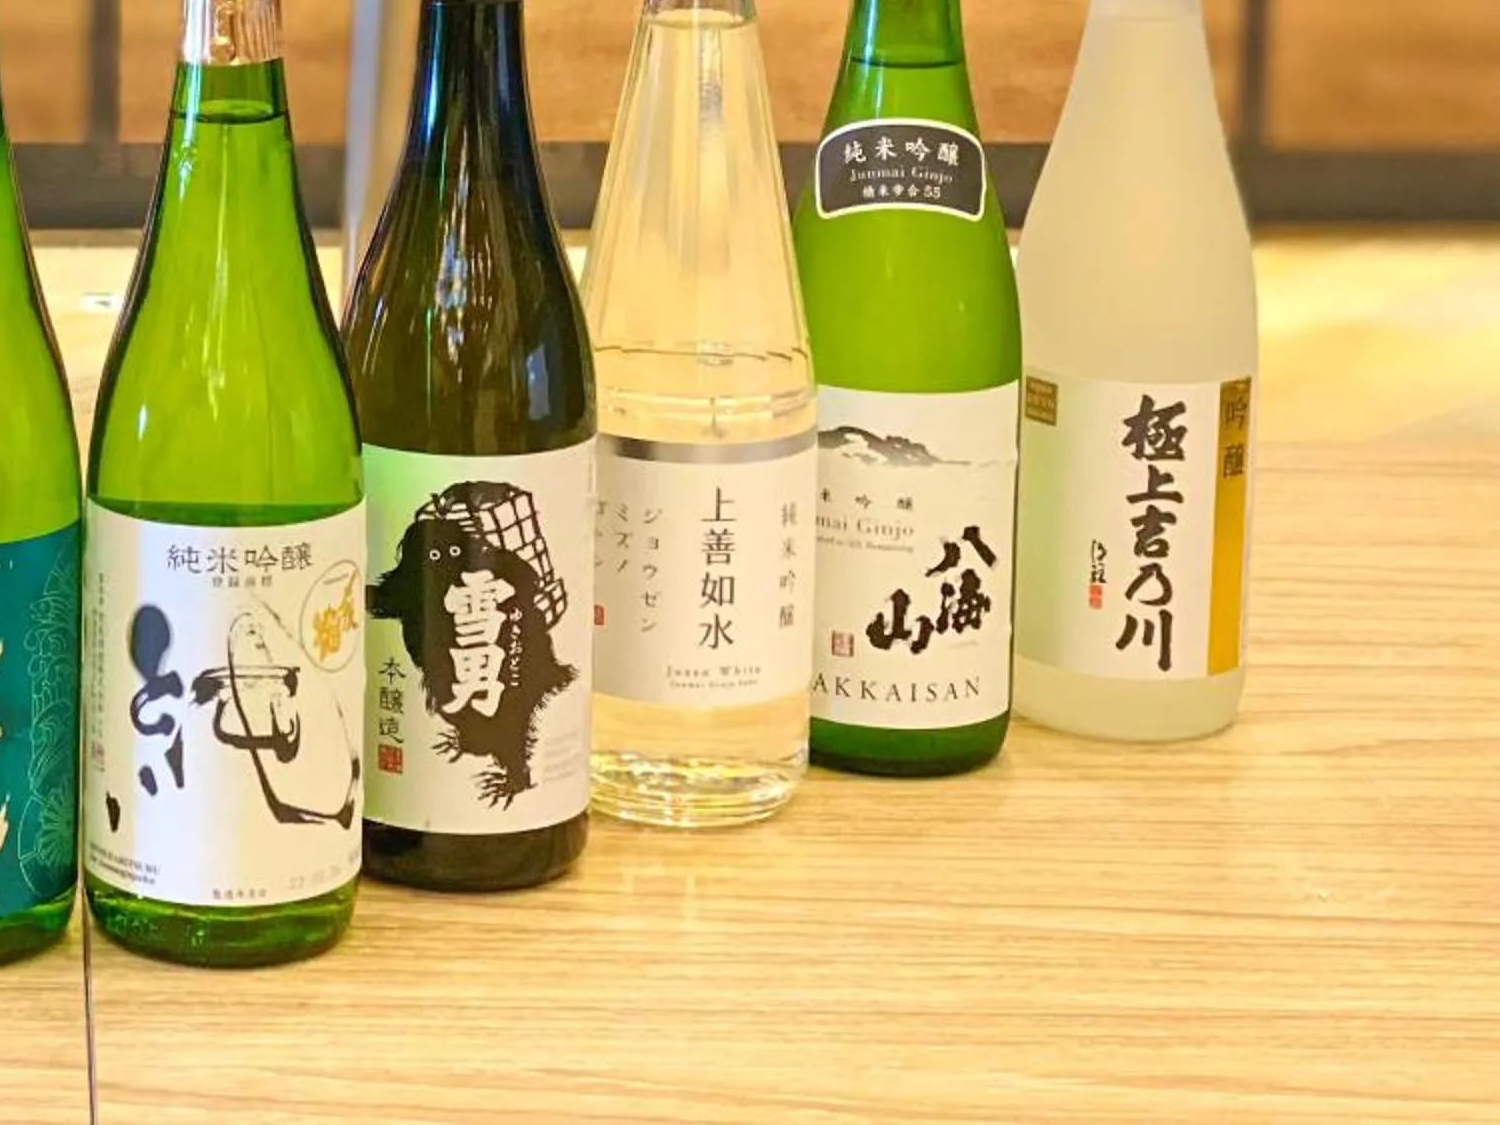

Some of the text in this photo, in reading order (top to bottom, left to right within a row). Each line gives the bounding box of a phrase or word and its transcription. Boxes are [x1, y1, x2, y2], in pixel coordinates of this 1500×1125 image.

[844, 136, 960, 166] 純米吟醸
[820, 488, 913, 511] 米吟醸
[857, 519, 914, 540] Ginjo
[1115, 394, 1188, 672] 極上吉乃川
[167, 542, 313, 573] 純米吟醸
[640, 508, 663, 633] ジョウゼン
[699, 486, 737, 650] 上善如水
[866, 525, 997, 655] 八海山
[441, 570, 516, 717] 雪男
[379, 657, 406, 744] 本醸造
[812, 673, 980, 703] AKKAISAN
